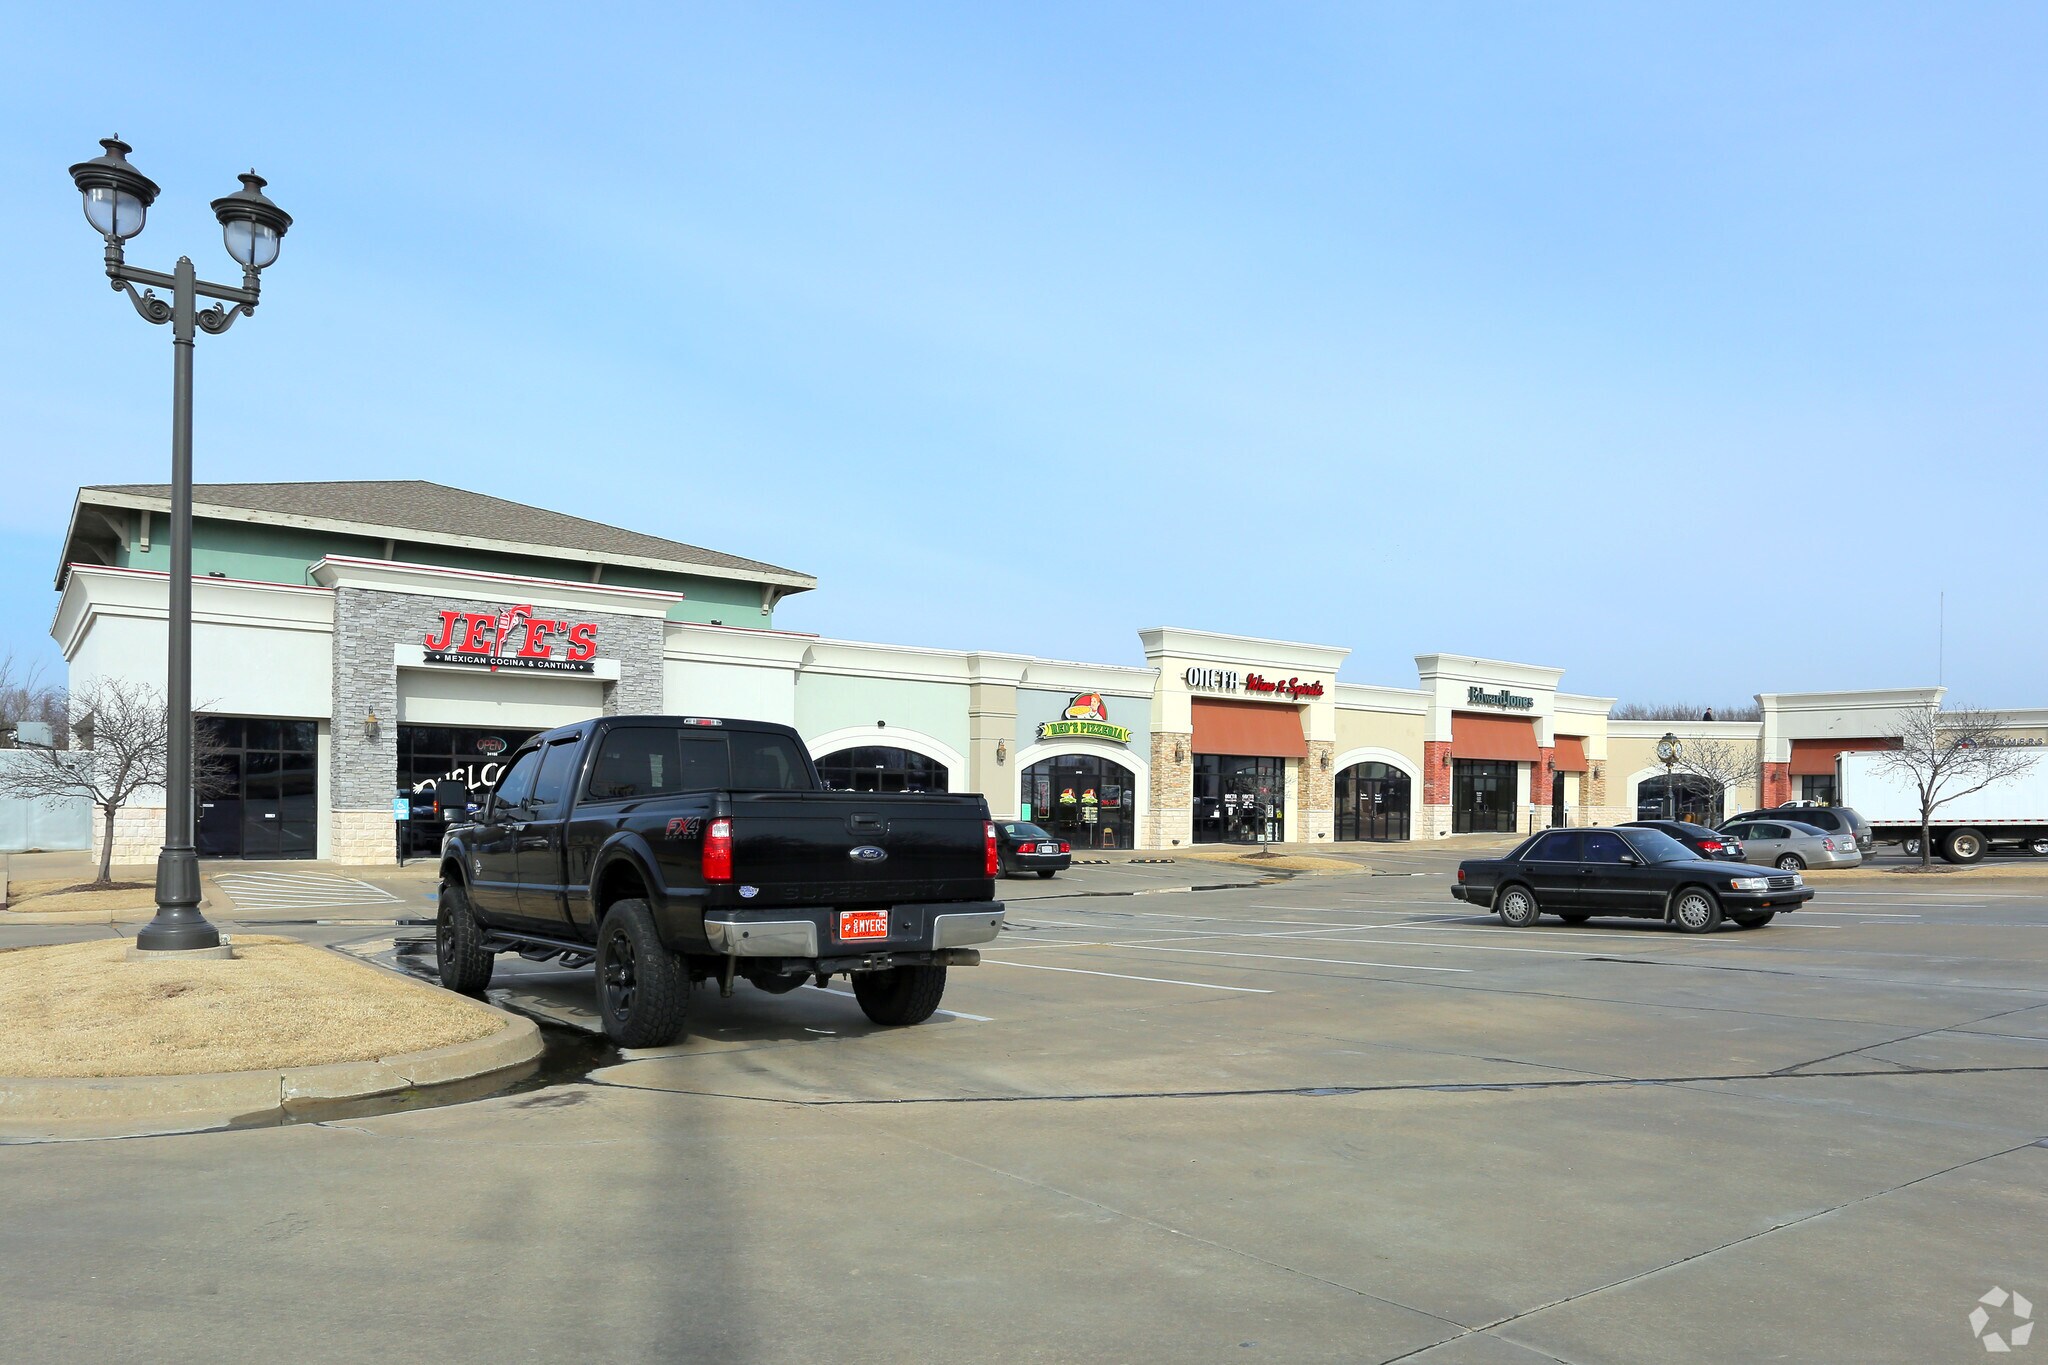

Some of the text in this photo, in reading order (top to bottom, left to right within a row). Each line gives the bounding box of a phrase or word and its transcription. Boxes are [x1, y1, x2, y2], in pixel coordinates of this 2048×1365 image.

[444, 654, 577, 670] MEXICAN COCINA & CANTINA
[1246, 672, 1276, 693] Wine
[1277, 679, 1287, 694] &
[1288, 676, 1324, 701] Spirits
[1468, 686, 1534, 708] Edward Jones
[1049, 721, 1125, 740] RED'S PIZZERIA
[476, 739, 502, 750] OPEN
[665, 815, 701, 835] FX4
[783, 885, 869, 900] SUPER
[859, 918, 886, 932] MYERS
